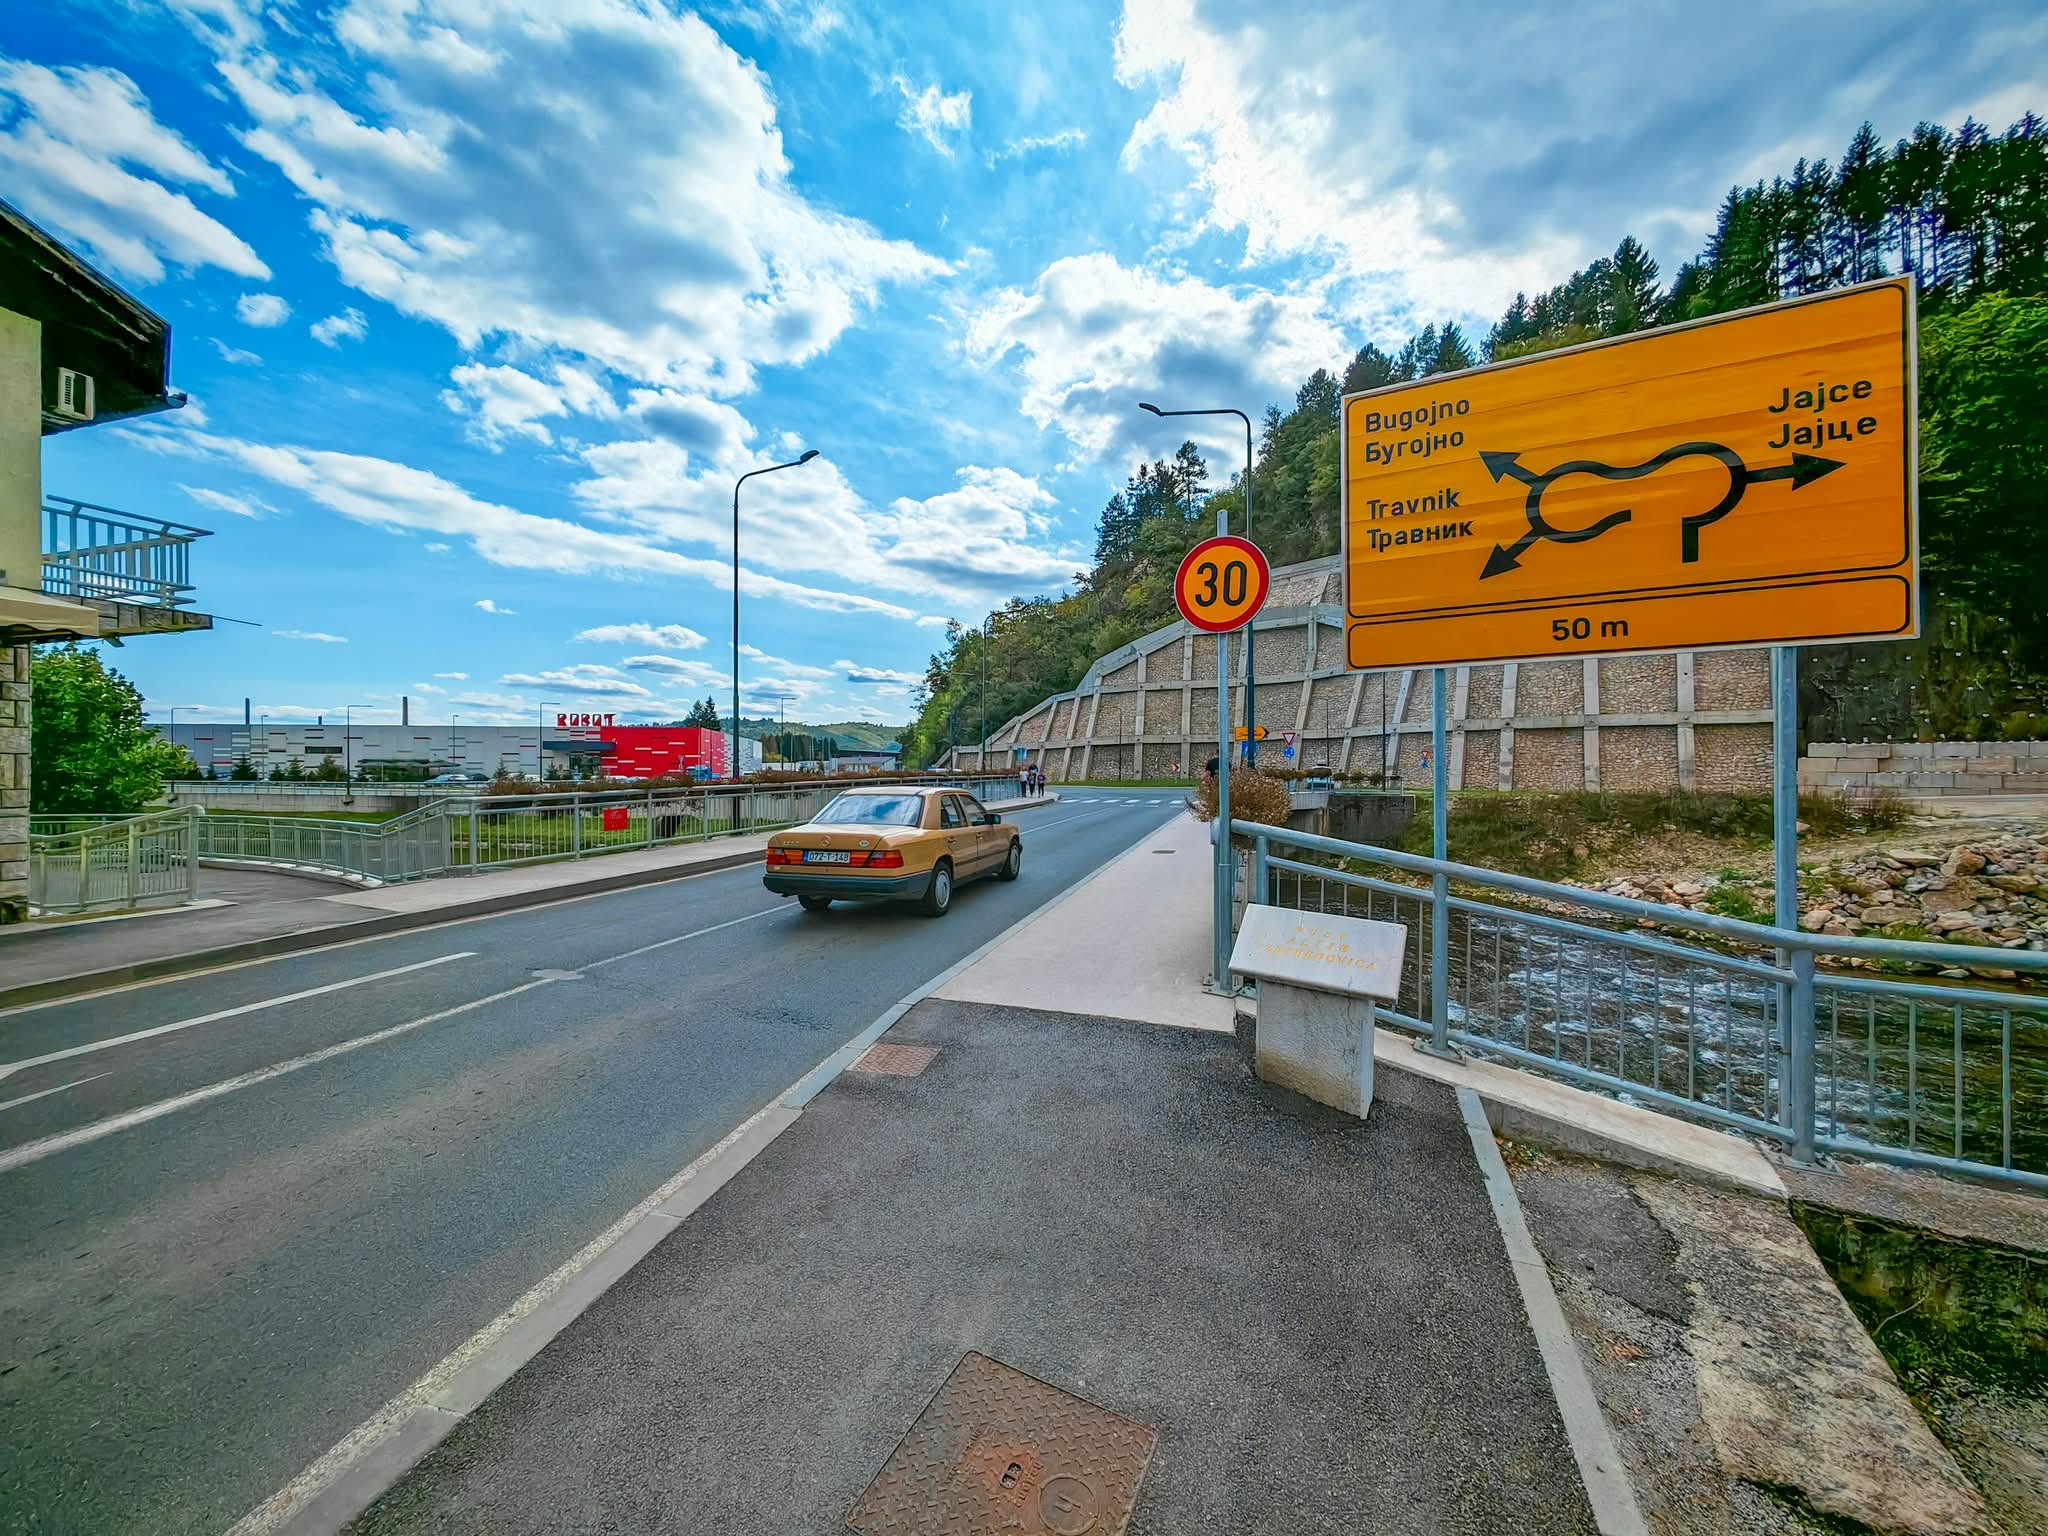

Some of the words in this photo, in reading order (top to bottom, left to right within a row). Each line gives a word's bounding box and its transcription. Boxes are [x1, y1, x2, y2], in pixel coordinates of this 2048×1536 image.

[1768, 380, 1872, 413] Jajce
[1366, 399, 1470, 433] Bugojno
[1366, 431, 1464, 465] Бугојно
[1367, 488, 1461, 520] Travnik
[1366, 520, 1474, 553] Травник
[1195, 560, 1248, 607] 30
[1552, 617, 1590, 641] 50
[1601, 620, 1629, 637] m
[557, 713, 616, 727] ROBOT
